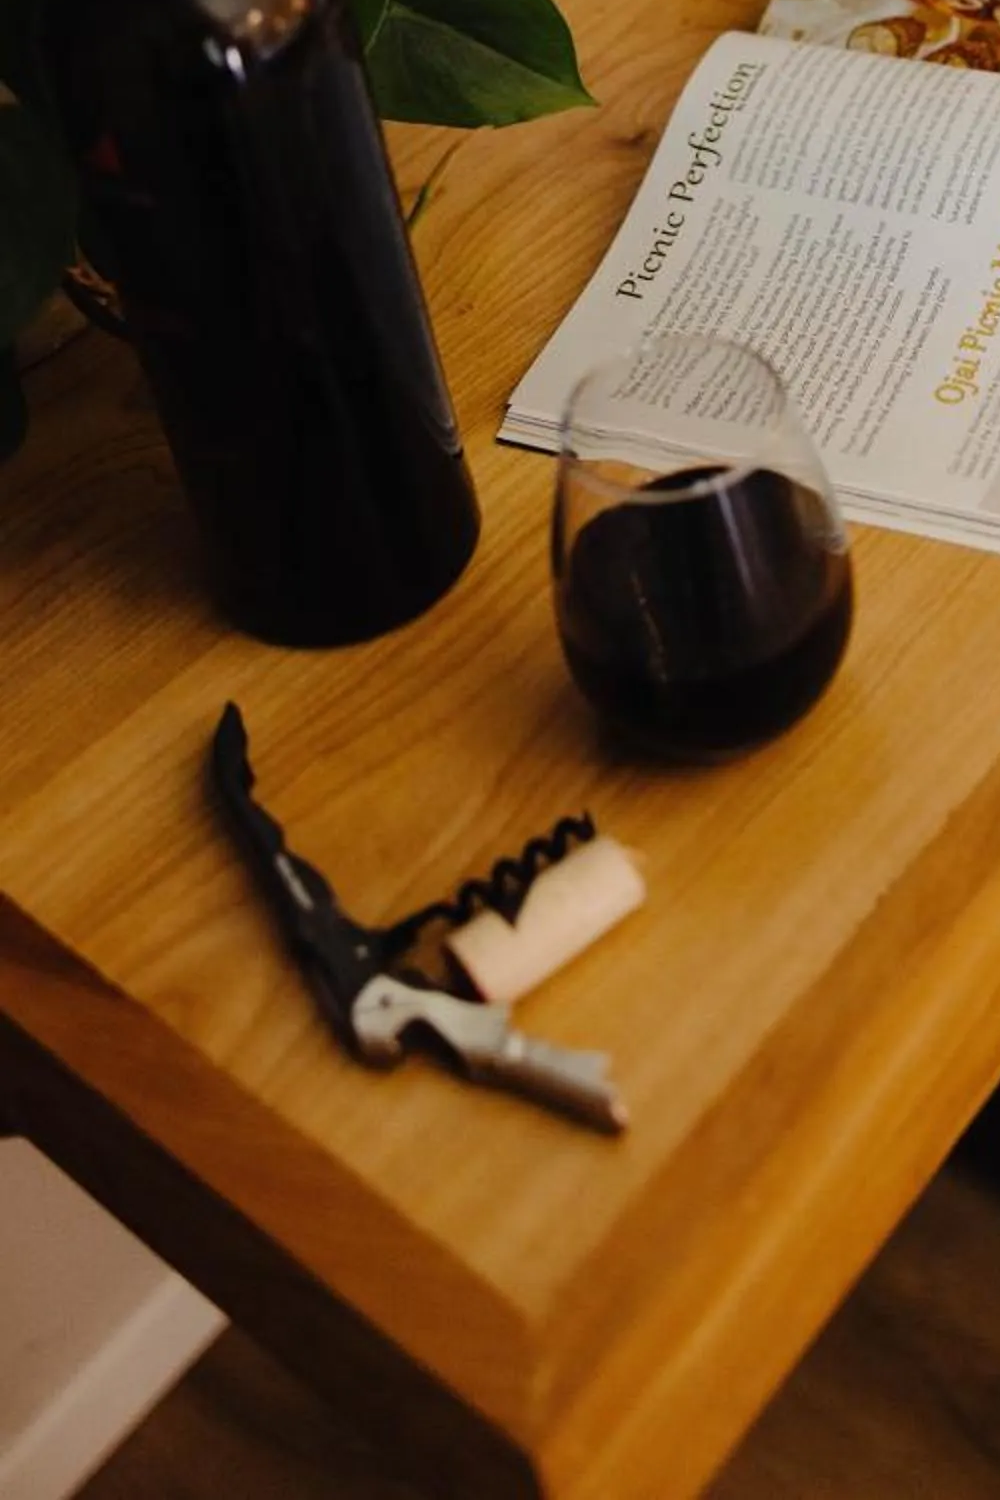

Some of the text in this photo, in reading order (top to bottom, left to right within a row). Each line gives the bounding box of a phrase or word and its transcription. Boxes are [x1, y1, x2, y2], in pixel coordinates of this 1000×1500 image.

[616, 60, 757, 300] Picnic Perfection
[934, 356, 981, 404] Ojai
